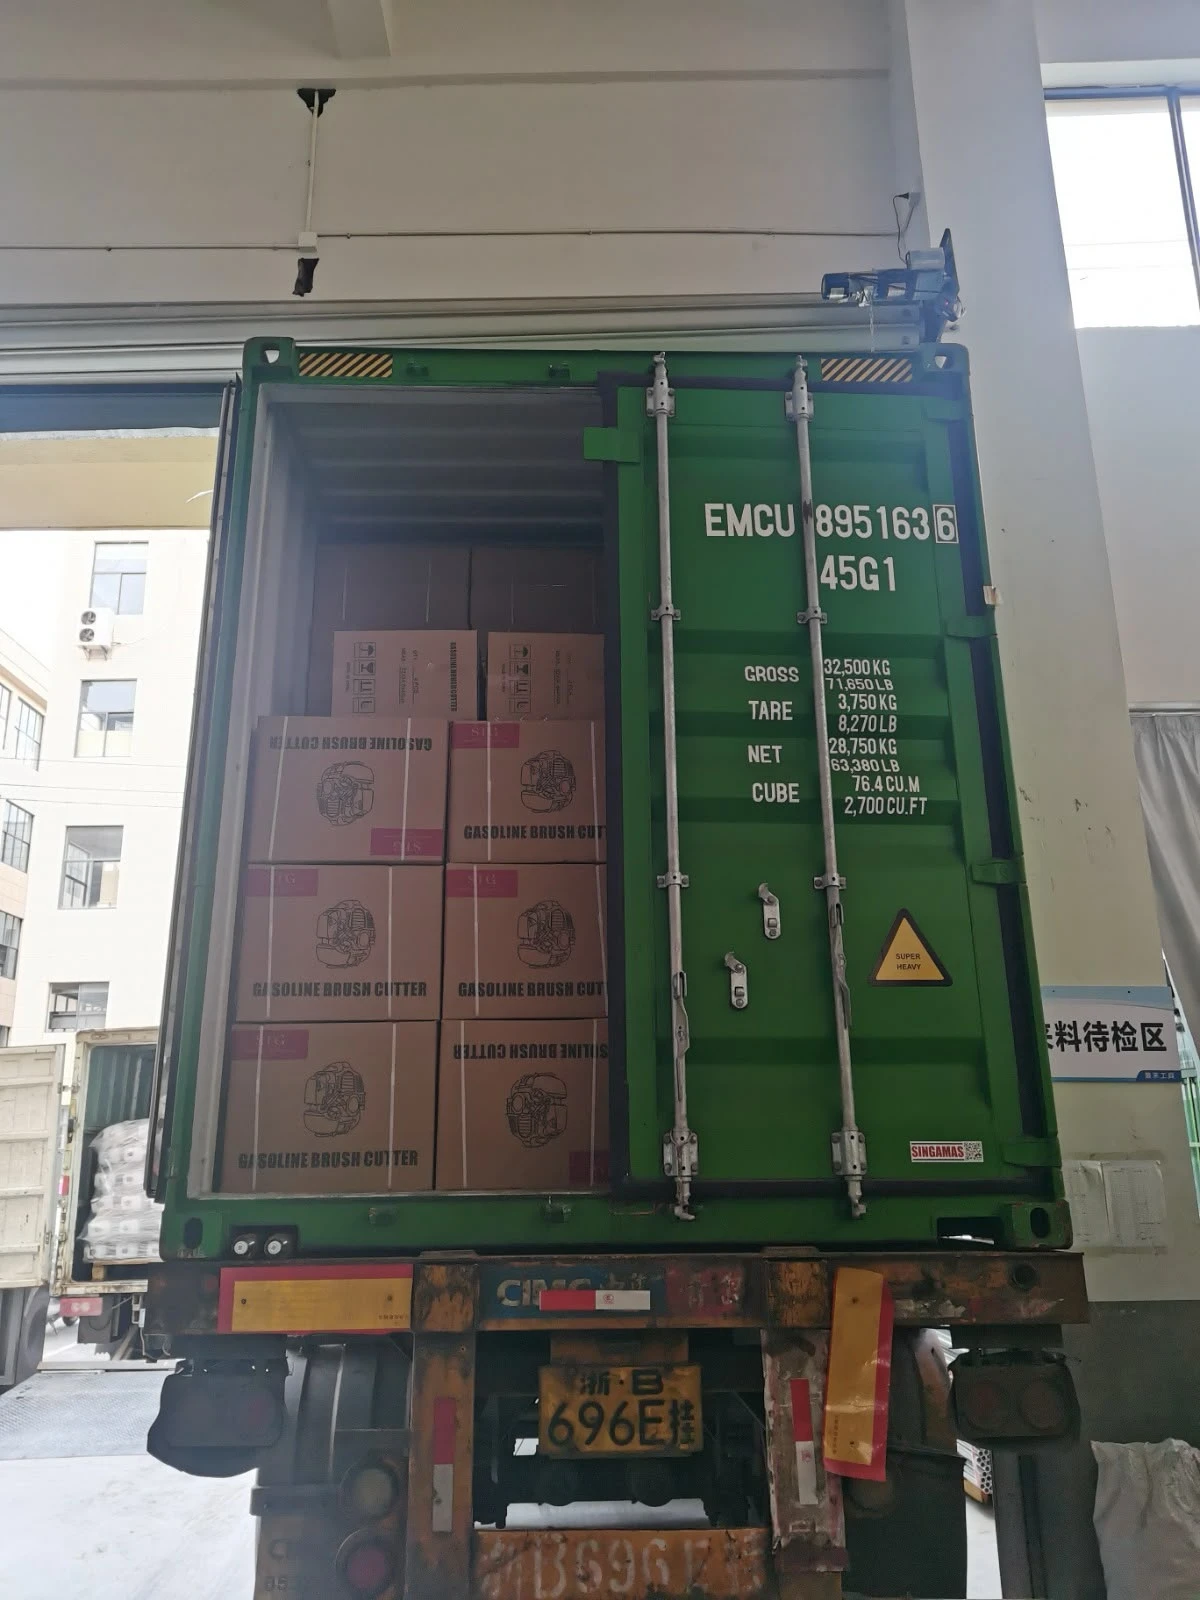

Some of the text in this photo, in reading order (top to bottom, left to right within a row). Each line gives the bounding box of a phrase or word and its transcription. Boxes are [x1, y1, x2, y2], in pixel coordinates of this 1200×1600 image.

[704, 503, 795, 537] EMCU
[820, 555, 896, 591] 45G1
[744, 666, 800, 682] GROSS
[823, 659, 891, 677] 32,500 KG
[825, 678, 894, 691] 71,650 LB
[748, 700, 793, 720] TARE
[838, 693, 898, 712] 3,750 KG
[838, 714, 897, 734] 8,270 LB
[322, 736, 367, 750] BRUSH
[369, 737, 432, 751] GASOLINE
[828, 737, 898, 756] 28,750 KG
[747, 744, 782, 763] NET
[831, 758, 900, 773] 63,380 LB
[851, 775, 920, 792] 76.4 CU.M
[752, 782, 800, 803] CUBE
[844, 796, 928, 816] 2,700 CU.FT
[463, 825, 527, 839] GASOLINE
[530, 825, 575, 839] BRUSH
[252, 981, 427, 997] GASOLINE BRUSH CUTTER
[458, 982, 524, 997] GASOLINE
[527, 981, 574, 997] BRUSH
[453, 1043, 506, 1059] CUTTER
[509, 1043, 556, 1059] BRUSH
[238, 1150, 418, 1169] GASOLINE BRUSH CUTTER
[911, 1145, 965, 1158] SINGAMAS
